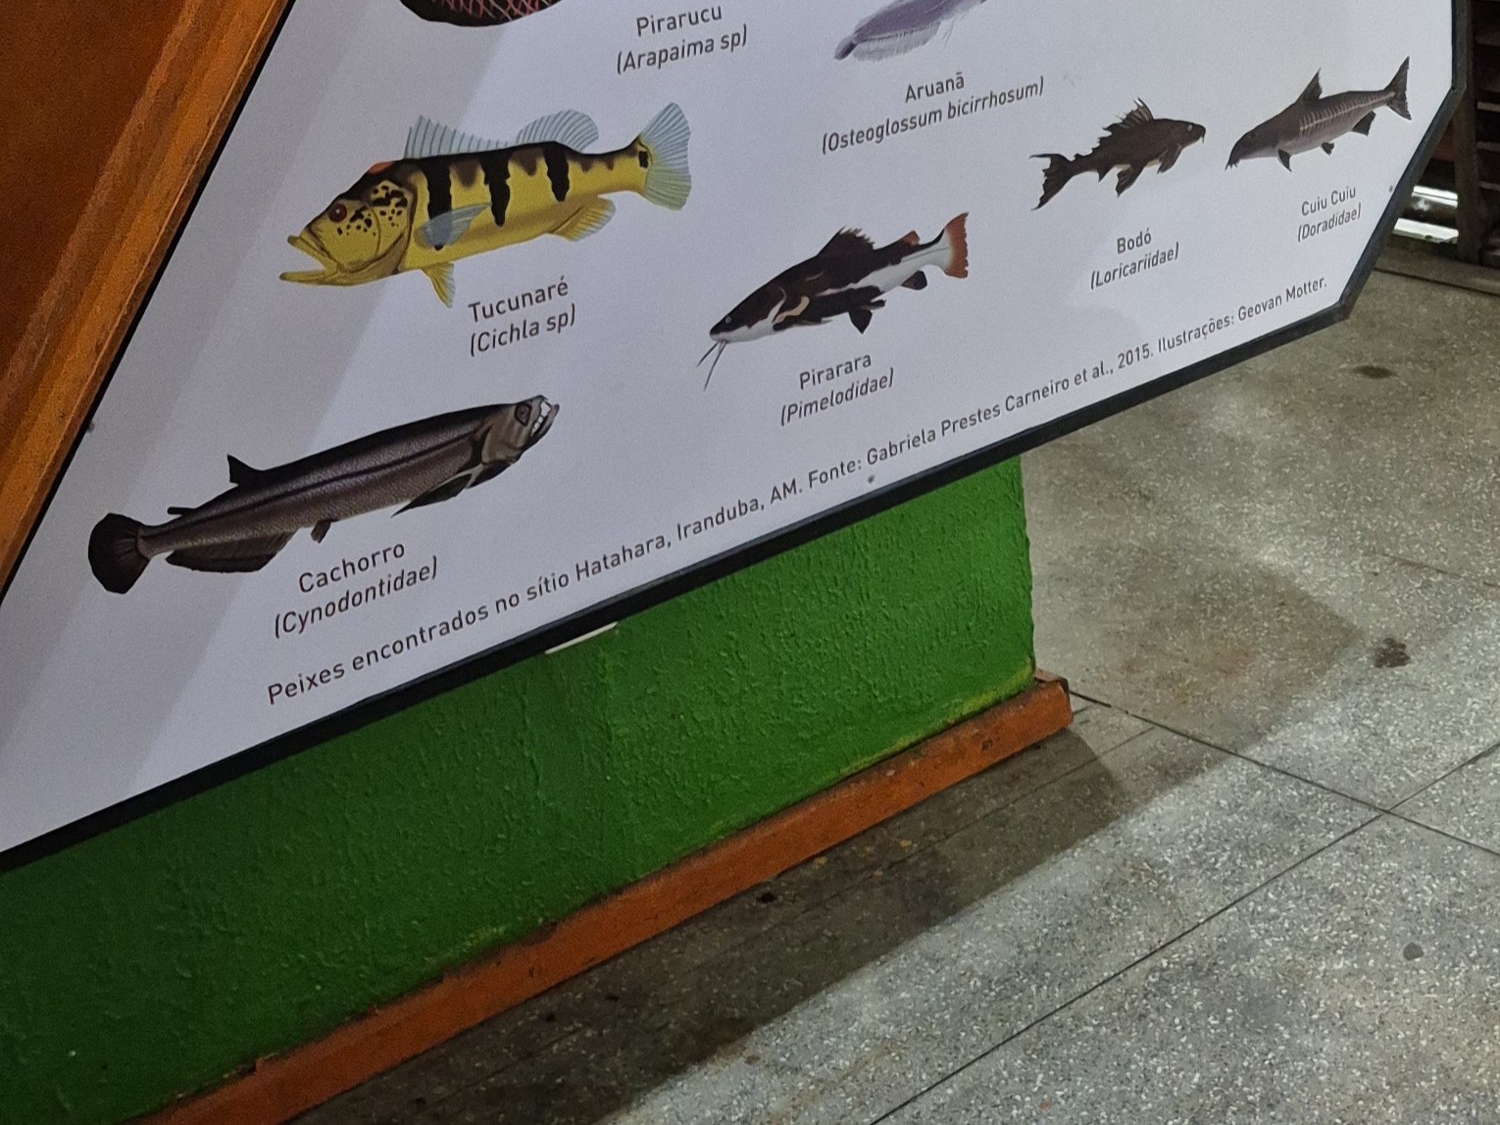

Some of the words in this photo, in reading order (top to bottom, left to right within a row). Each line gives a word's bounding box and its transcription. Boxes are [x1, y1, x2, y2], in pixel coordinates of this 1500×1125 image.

[636, 5, 723, 38] Pirarucu
[616, 38, 715, 76] (Arapaima
[720, 22, 747, 53] sp)
[904, 71, 965, 104] Aruanã
[821, 108, 943, 156] (Osteoglossum
[947, 75, 1044, 120] bicirrhosum)
[1297, 202, 1362, 243] (Doradidae)
[1301, 197, 1328, 217] Cuiu
[1330, 186, 1356, 206] Cuiu
[1090, 240, 1180, 291] (Loricariidae)
[1116, 227, 1153, 255] Bodó
[467, 274, 569, 323] Tucunaré
[470, 318, 540, 358] (Cichla
[546, 302, 576, 334] sp)
[780, 366, 894, 427] (Pimelodidae)
[799, 354, 872, 391] Pirarara
[267, 662, 345, 706] Peixes
[352, 605, 489, 671] encontrados
[495, 593, 520, 614] no
[526, 573, 570, 602] sítio
[575, 535, 672, 582] Hatahara,
[676, 498, 765, 541] Iranduba,
[769, 477, 803, 505] AM.
[808, 459, 862, 489] Fonte:
[866, 428, 936, 466] Gabriela
[940, 404, 1001, 438] Prestes
[1005, 378, 1070, 412] Carneiro
[1073, 368, 1088, 386] et
[1117, 342, 1154, 370] 2015.
[1158, 315, 1235, 353] Ilustrações:
[1237, 294, 1283, 322] Geovan
[1285, 276, 1328, 303] Motter.
[298, 543, 405, 593] Cachorro
[274, 554, 438, 640] (Cynodontidae)
